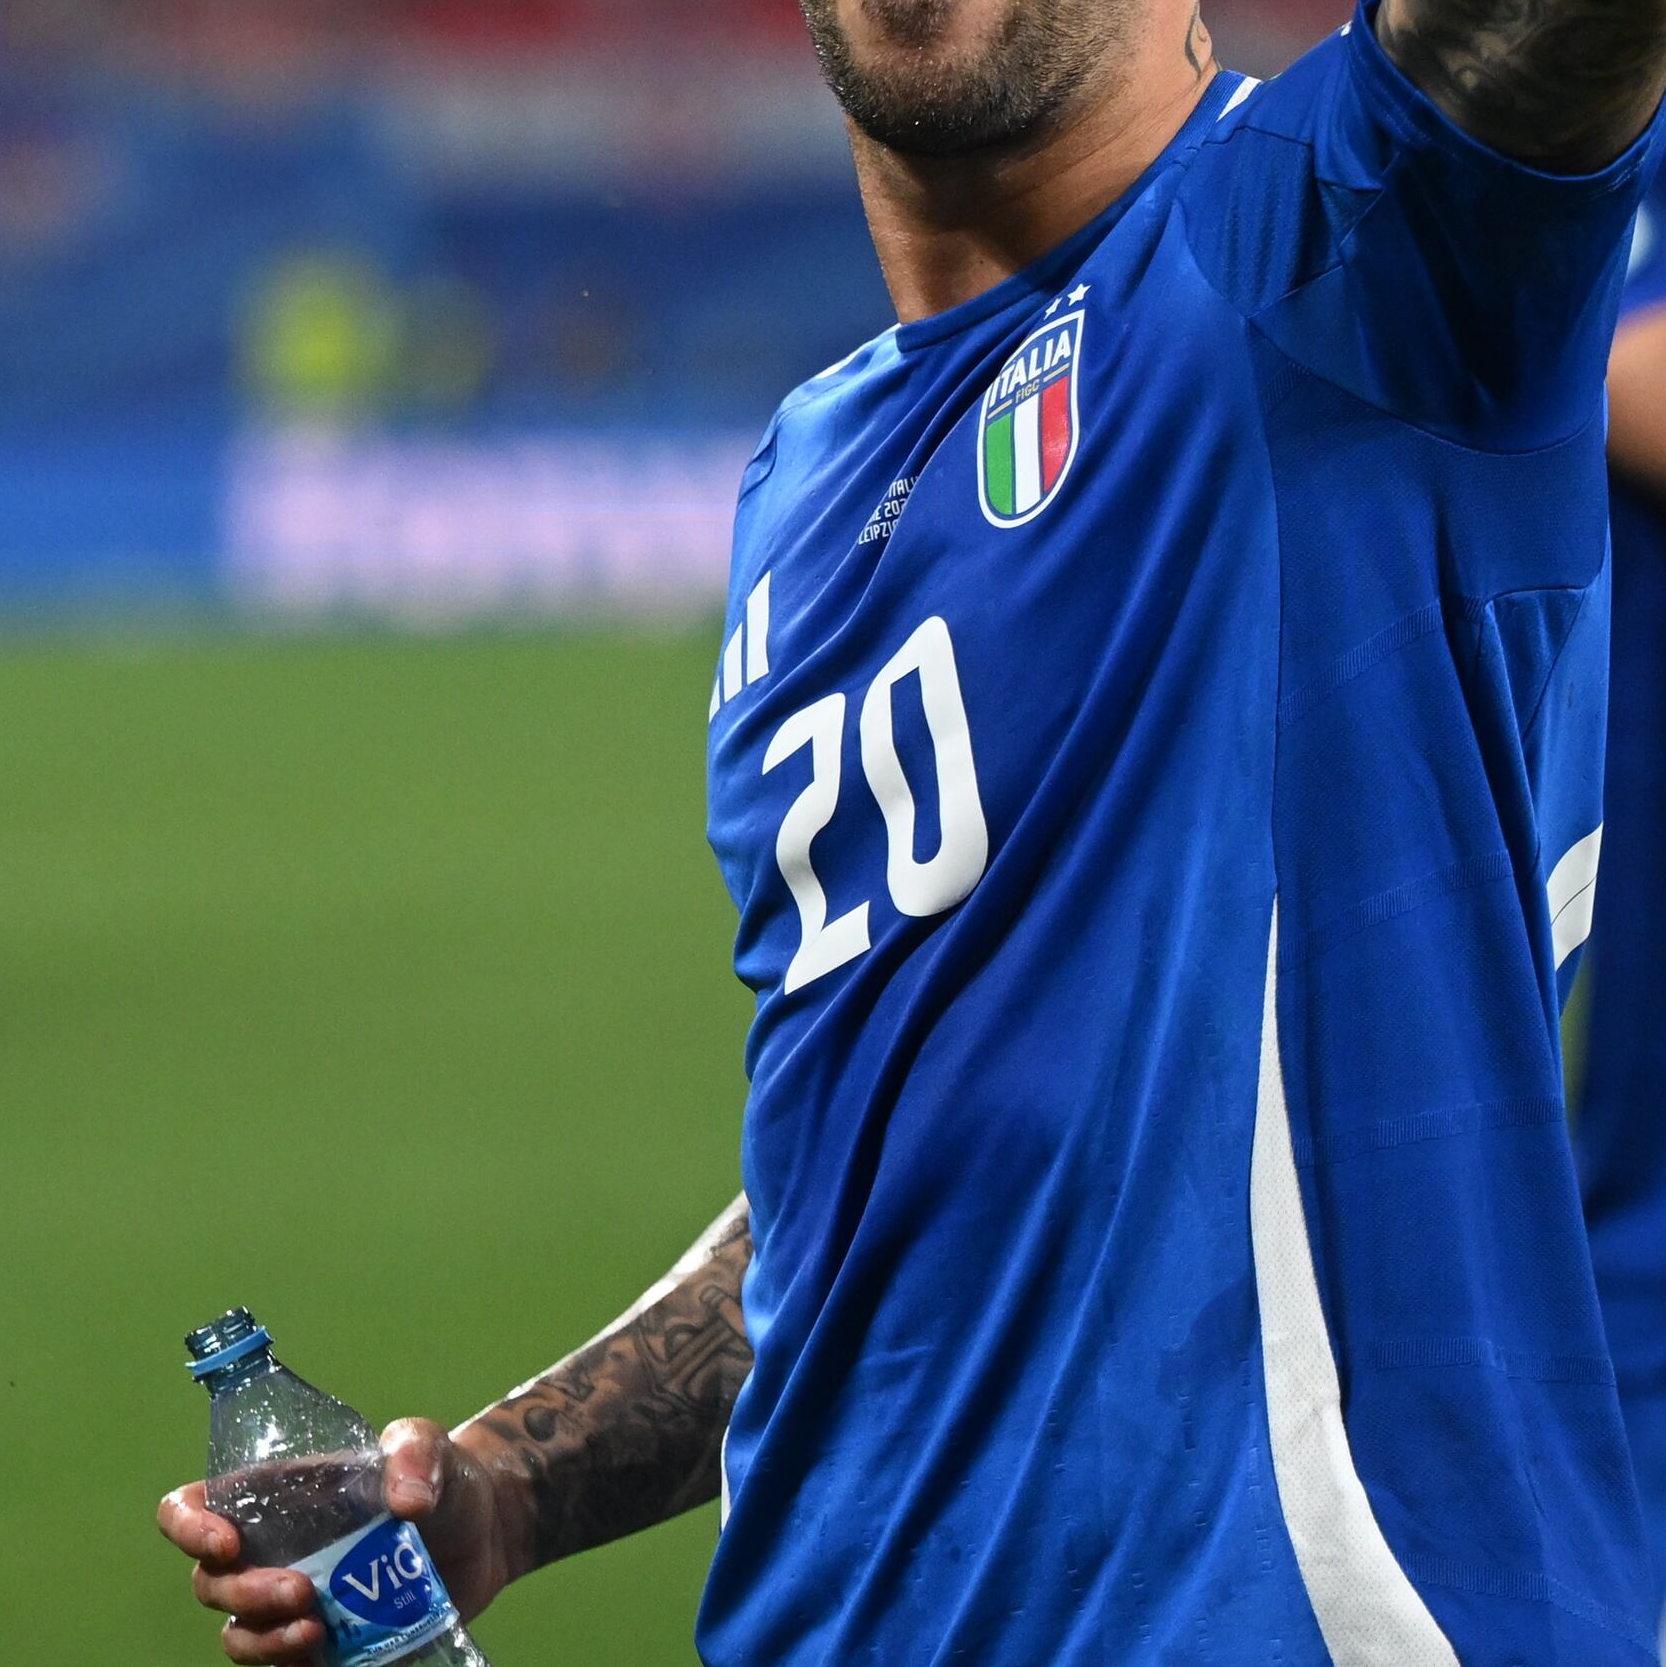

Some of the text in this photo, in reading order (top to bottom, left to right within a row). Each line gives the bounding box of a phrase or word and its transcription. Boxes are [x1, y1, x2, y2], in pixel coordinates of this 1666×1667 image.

[989, 329, 1071, 408] ITALIA
[1016, 379, 1040, 404] FIGC
[763, 615, 988, 996] 20
[393, 1590, 416, 1609] Still
